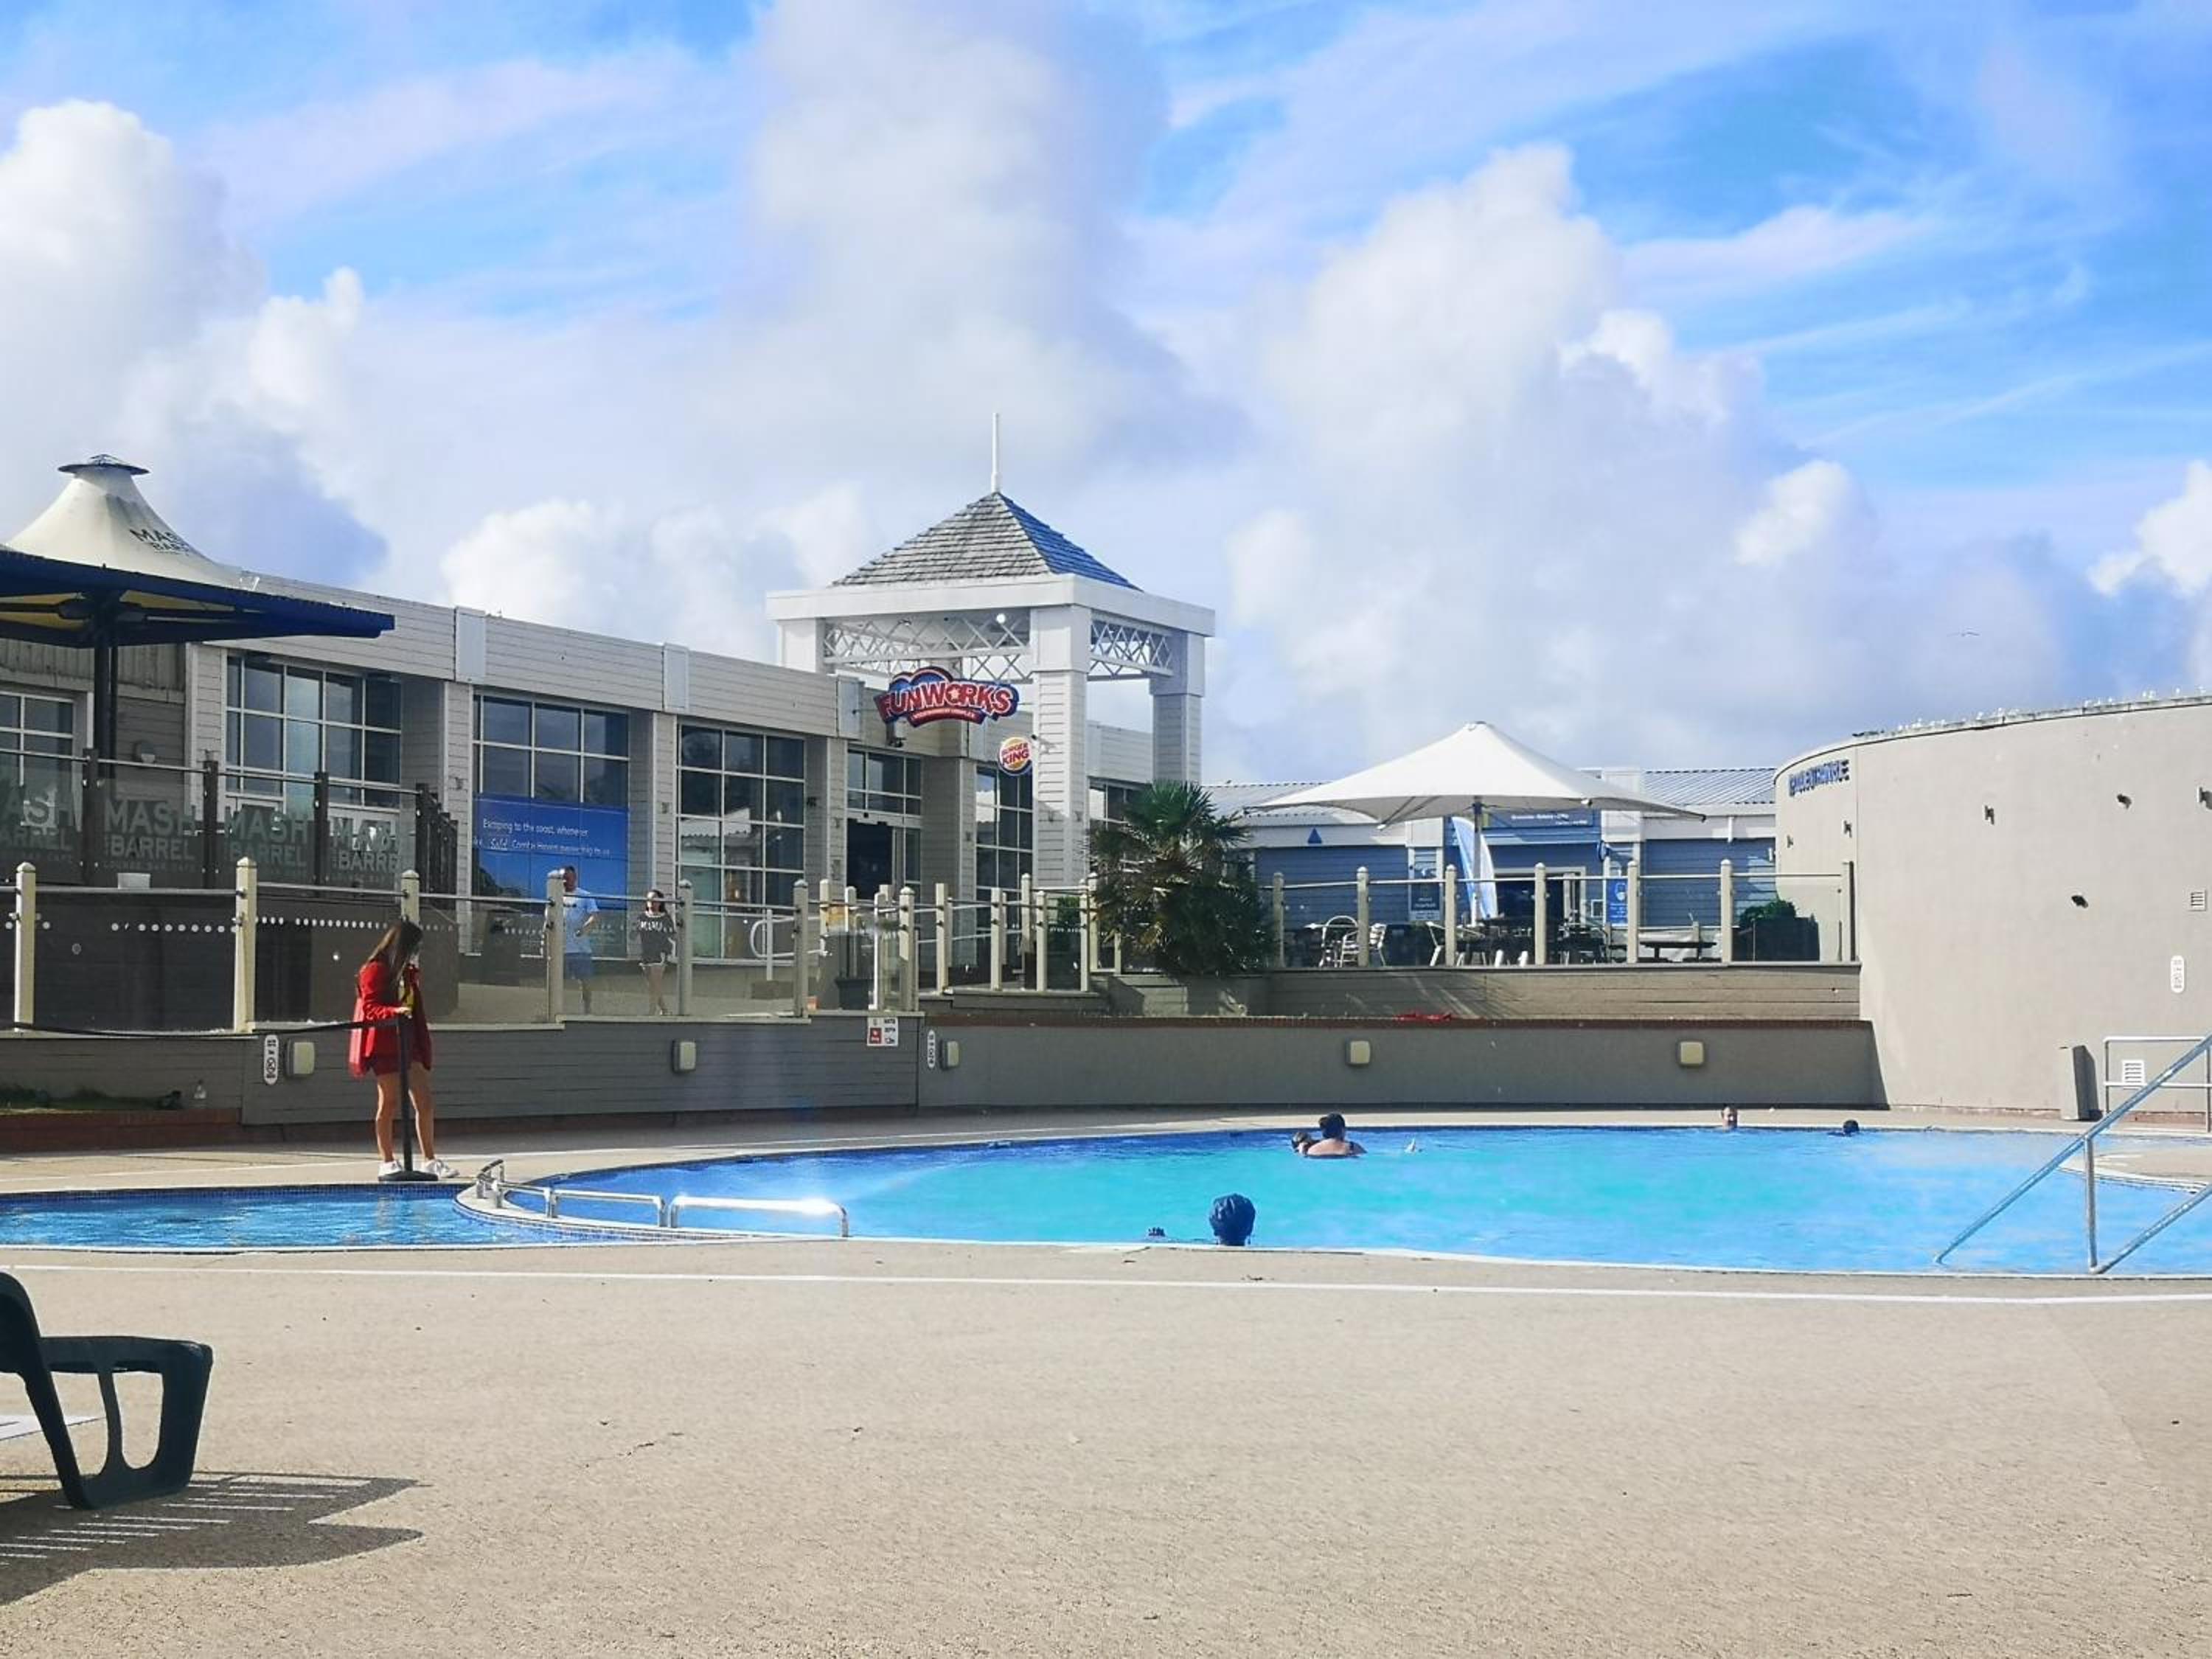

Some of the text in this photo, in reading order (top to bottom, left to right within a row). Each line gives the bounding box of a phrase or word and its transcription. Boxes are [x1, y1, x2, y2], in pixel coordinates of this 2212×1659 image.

[879, 681, 1012, 718] FUNWORKS
[1003, 749, 1029, 764] KING
[104, 799, 197, 836] MASH
[223, 809, 307, 844] MASH
[111, 834, 195, 860] BARREL
[229, 841, 307, 867] BARREL
